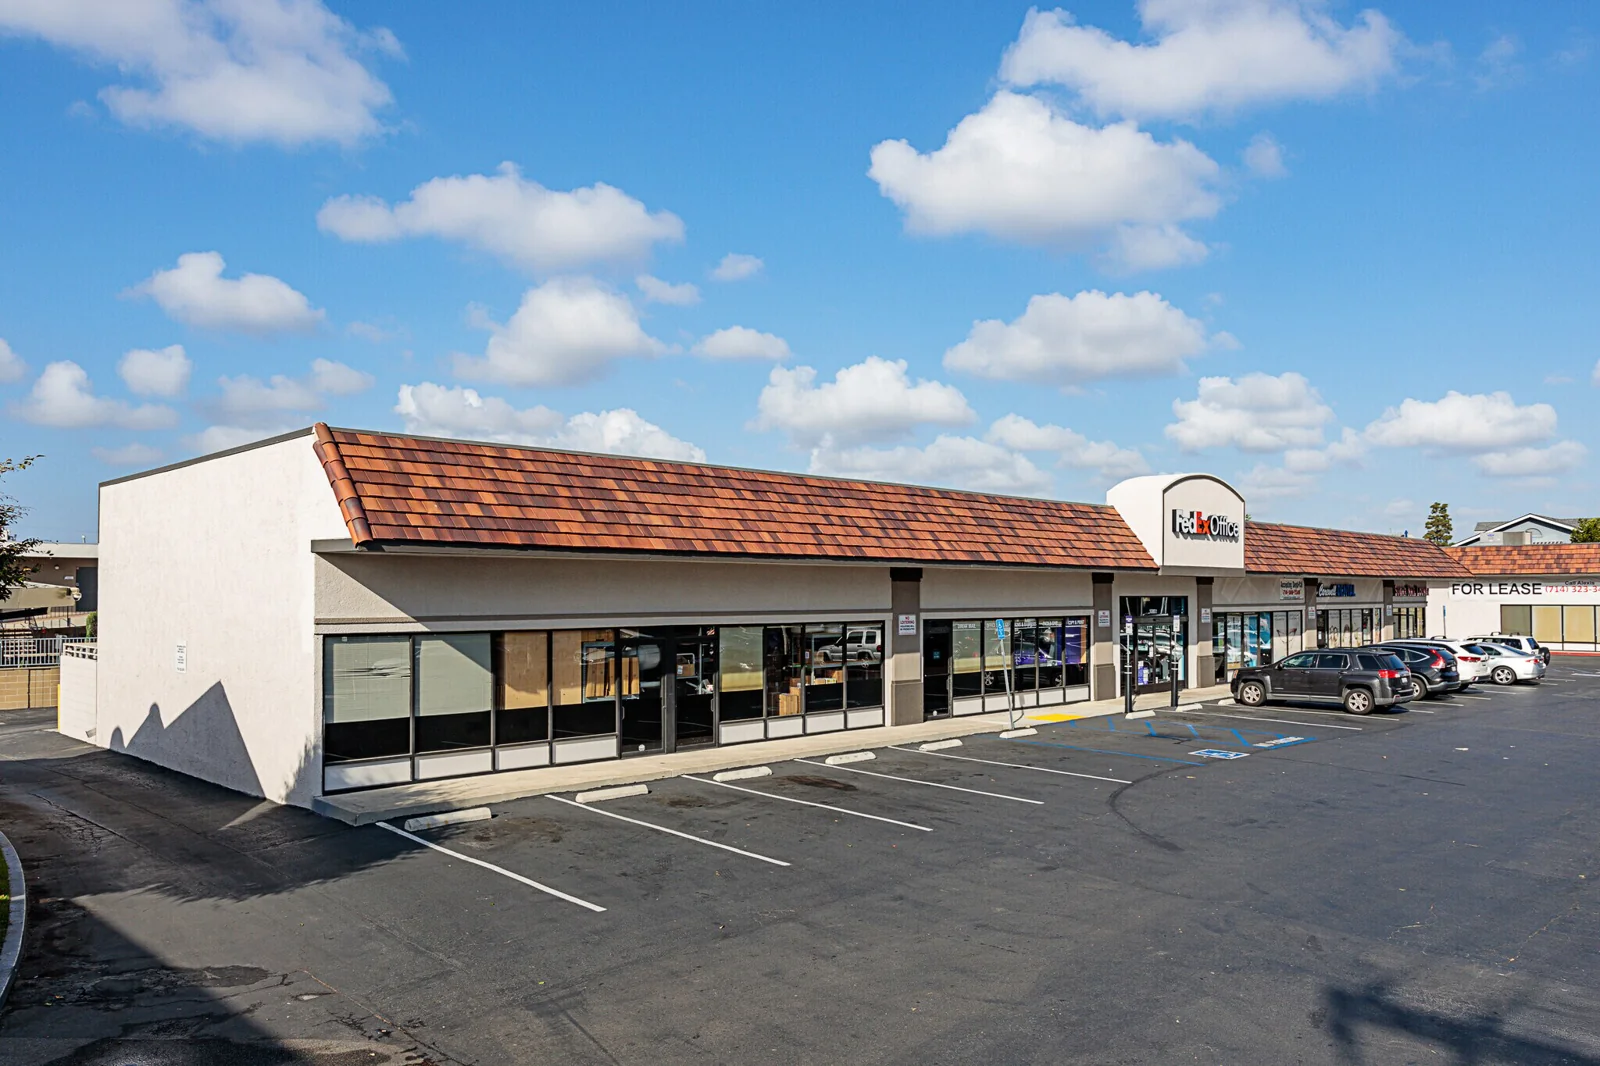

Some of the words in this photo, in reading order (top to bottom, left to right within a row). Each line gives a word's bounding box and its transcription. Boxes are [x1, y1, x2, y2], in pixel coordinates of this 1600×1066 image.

[1172, 509, 1211, 535] FedEx
[1209, 514, 1239, 537] Office
[1452, 583, 1484, 595] FOR
[1488, 583, 1542, 595] LEASE
[1545, 585, 1569, 593] (714)
[1571, 585, 1600, 593] 323-3
